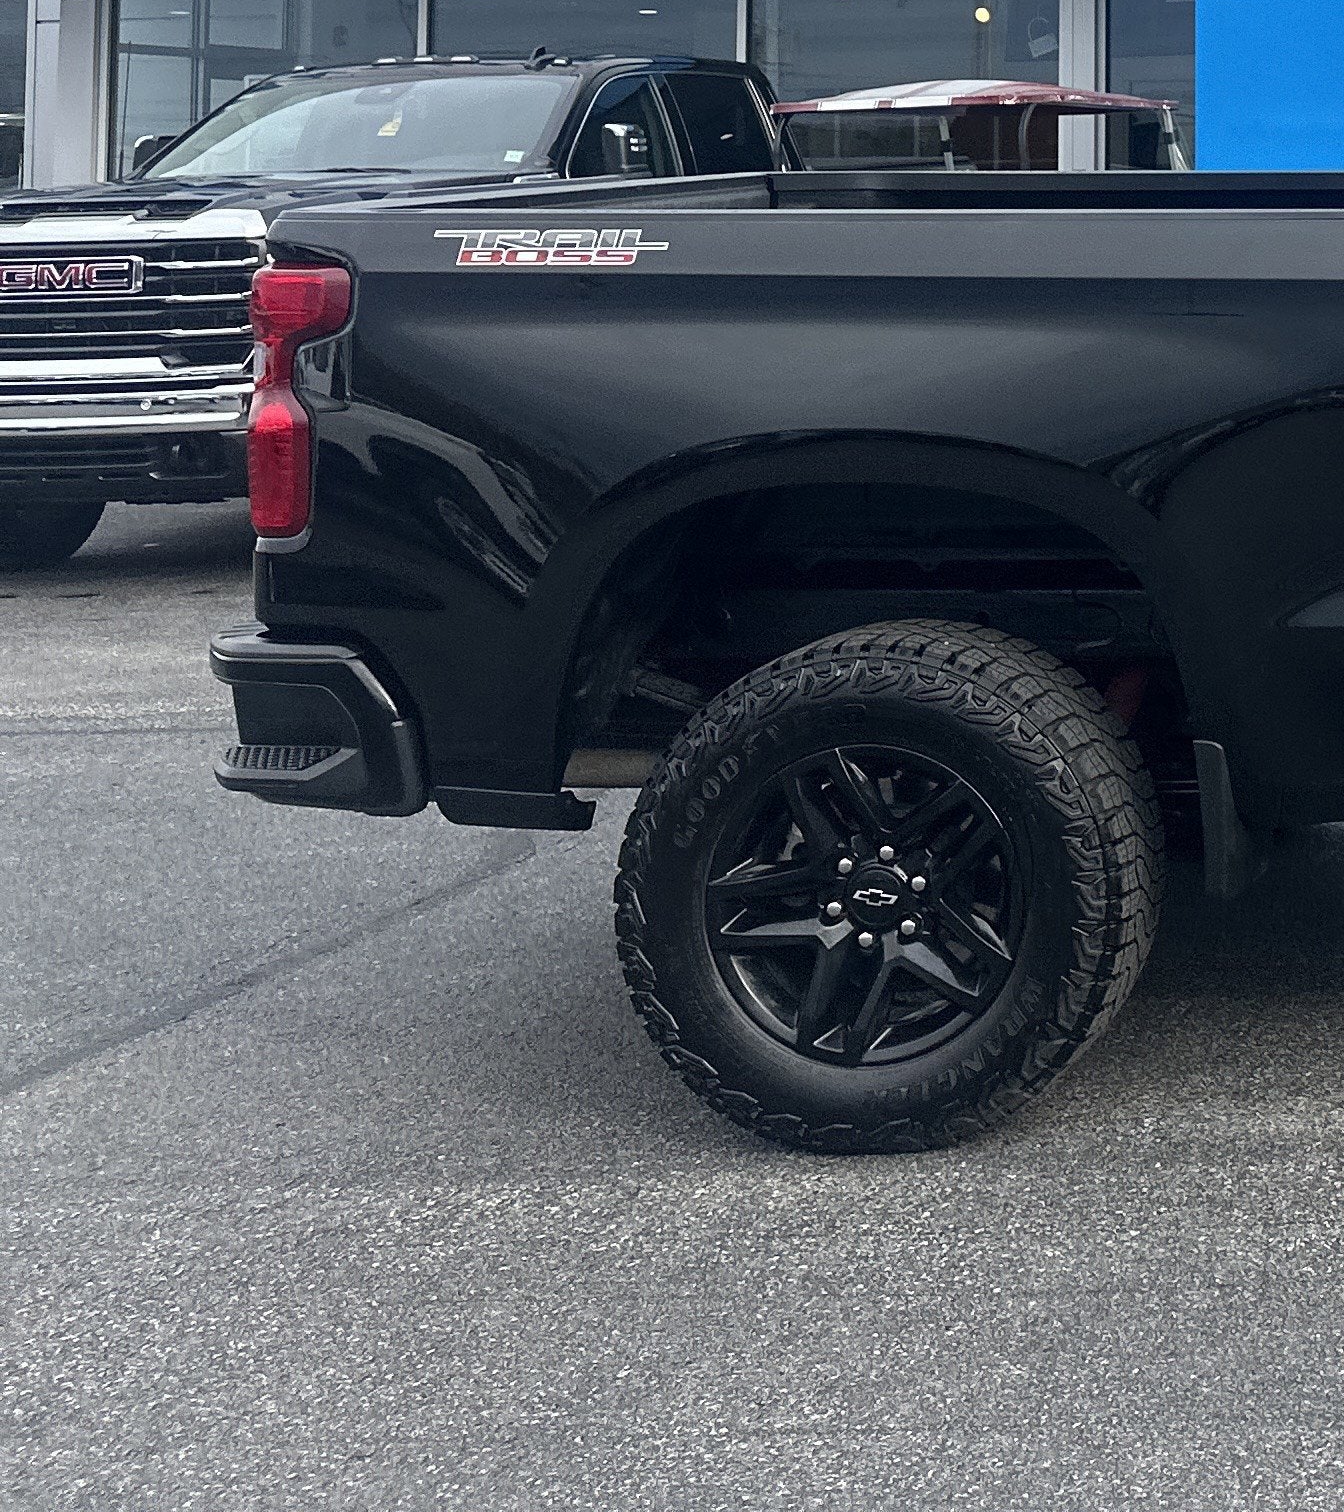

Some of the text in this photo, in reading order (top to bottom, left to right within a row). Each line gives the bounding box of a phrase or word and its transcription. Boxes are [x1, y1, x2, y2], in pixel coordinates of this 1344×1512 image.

[433, 229, 670, 251] TRAIL
[456, 248, 637, 266] BOSS
[0, 262, 130, 291] GMC
